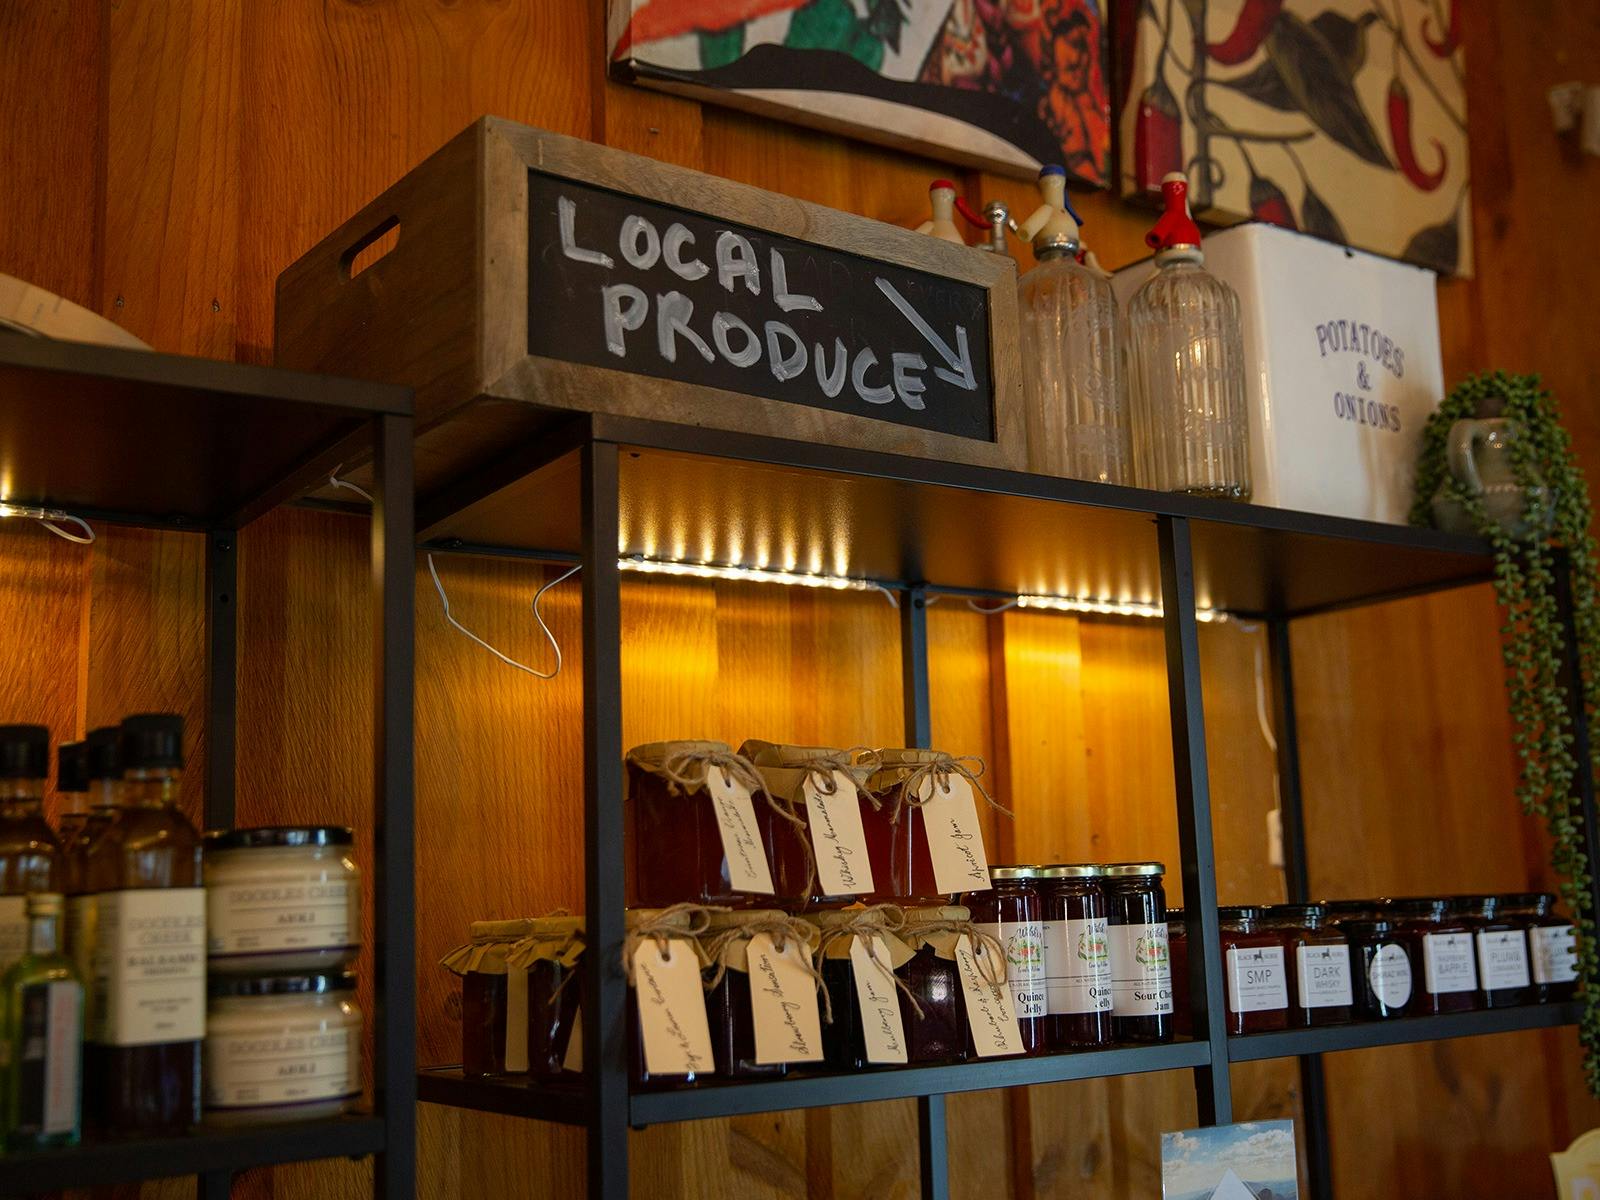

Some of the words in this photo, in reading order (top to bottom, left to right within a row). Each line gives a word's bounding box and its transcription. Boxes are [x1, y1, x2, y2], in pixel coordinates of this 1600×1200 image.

[558, 195, 823, 312] LOCAL
[602, 283, 928, 411] PRODUCE
[1316, 319, 1404, 378] POTATOES
[1357, 360, 1372, 391] &
[1334, 392, 1401, 432] ONIONS
[950, 817, 975, 841] Jam
[954, 845, 986, 882] Apricot
[1247, 969, 1273, 985] SMP
[1313, 966, 1342, 979] DARK
[866, 981, 889, 1004] Jam
[1134, 991, 1157, 1001] Sour
[1023, 1004, 1042, 1015] Jelly
[1155, 1002, 1169, 1011] Jam
